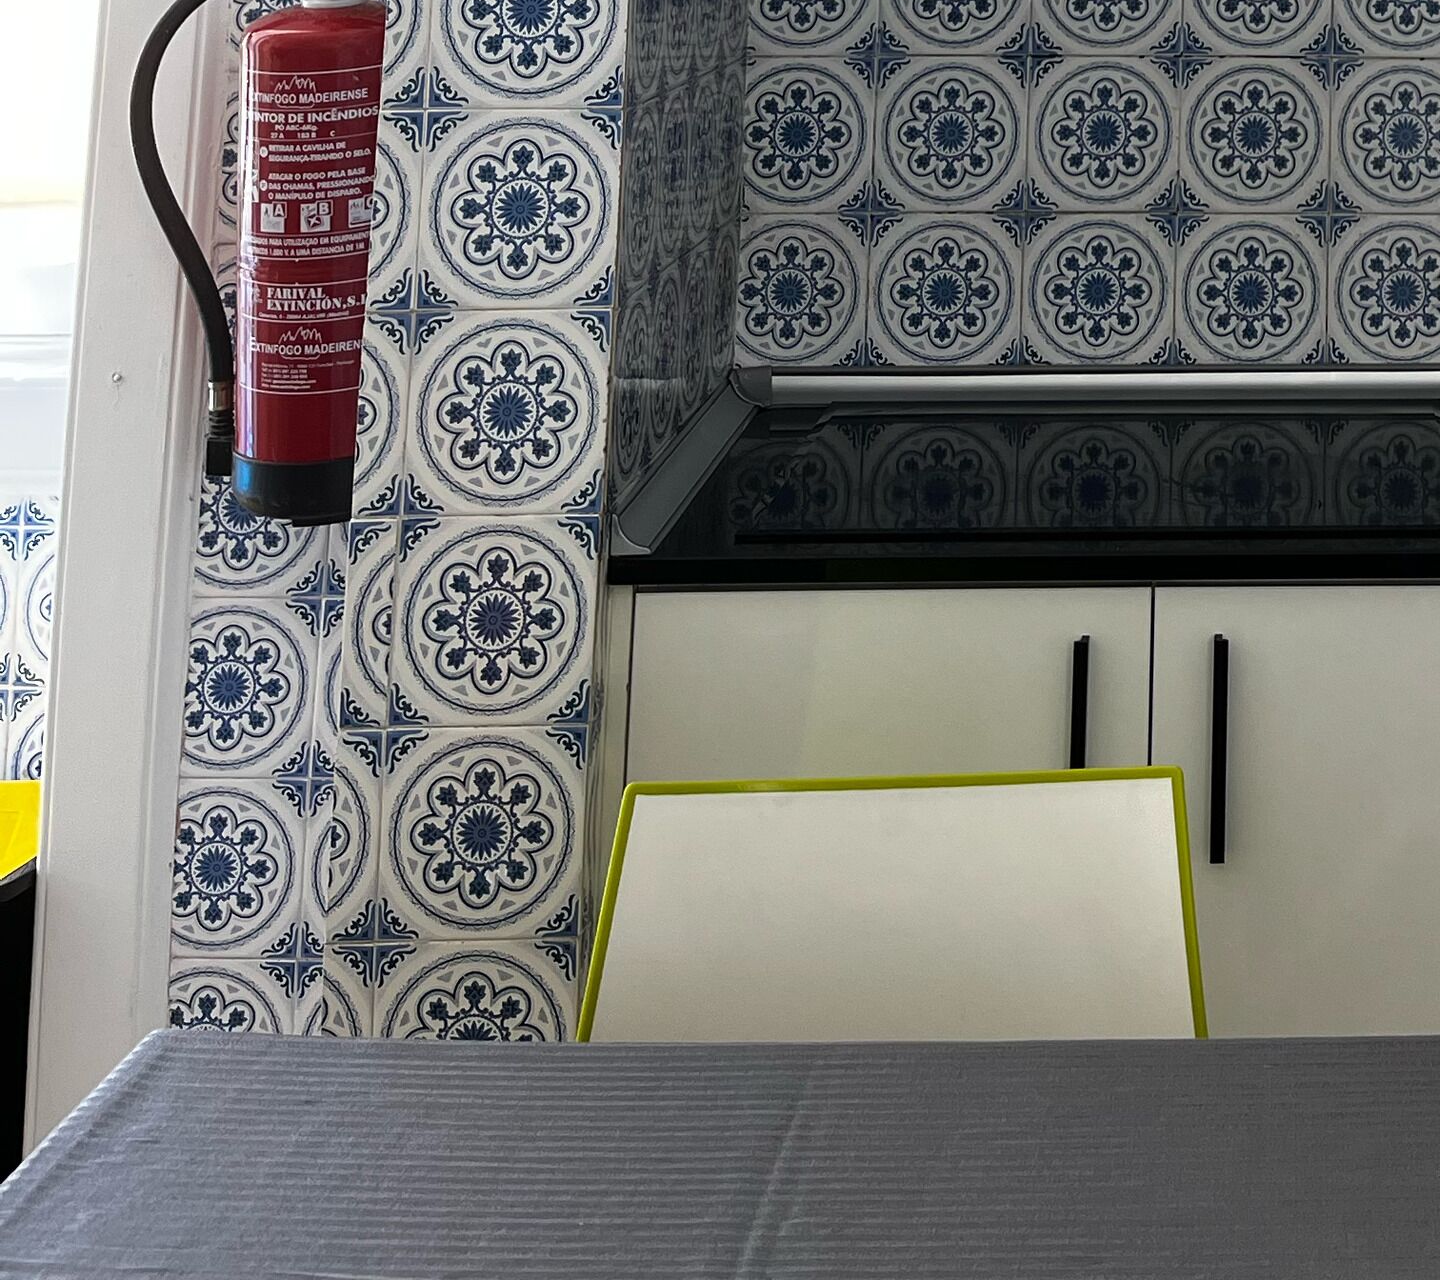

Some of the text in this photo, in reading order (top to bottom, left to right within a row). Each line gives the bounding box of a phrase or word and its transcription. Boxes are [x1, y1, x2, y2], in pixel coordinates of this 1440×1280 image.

[299, 88, 368, 103] MADEIRENSE
[288, 113, 304, 123] DE
[308, 106, 378, 123] INCÊNDIOS
[328, 170, 345, 178] PELA
[274, 204, 284, 216] A
[319, 203, 329, 214] B
[267, 288, 325, 299] FARIVAL
[304, 340, 360, 354] MADEIREN
